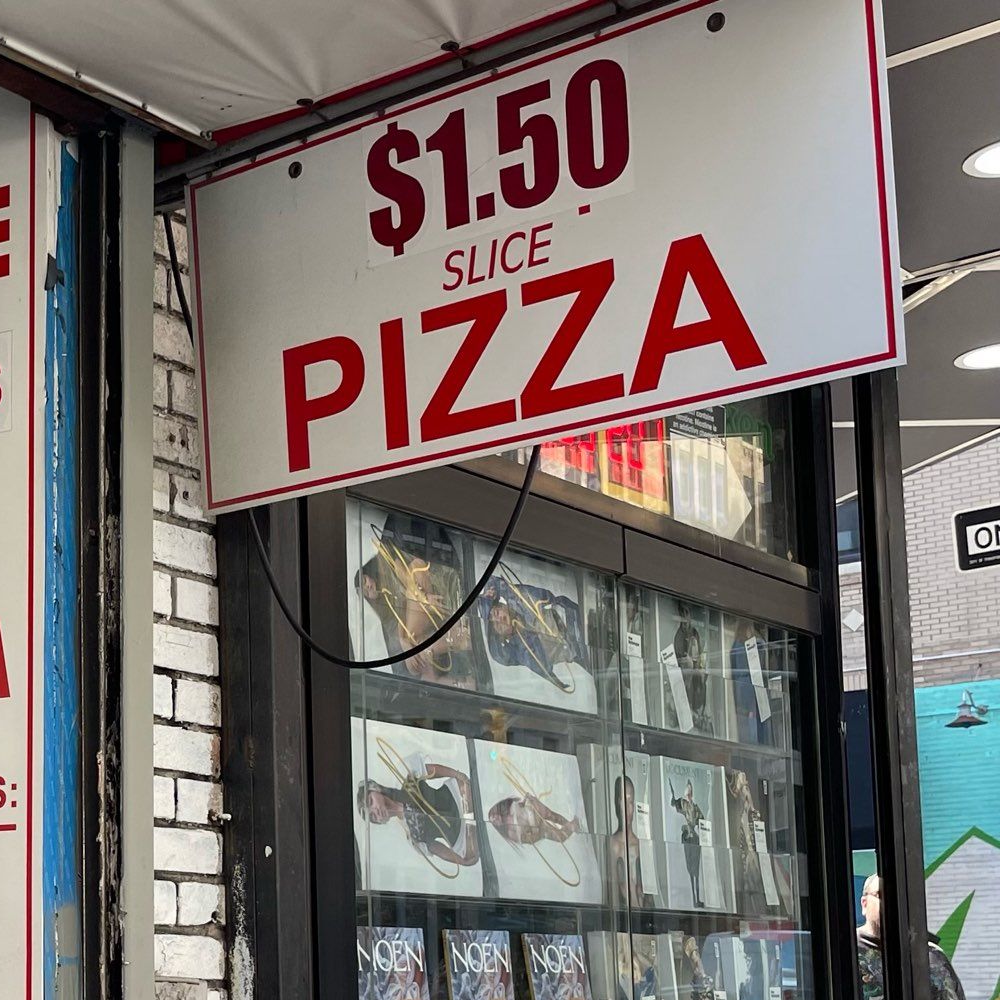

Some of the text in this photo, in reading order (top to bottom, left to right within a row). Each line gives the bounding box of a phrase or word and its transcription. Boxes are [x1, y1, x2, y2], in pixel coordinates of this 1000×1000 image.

[366, 57, 631, 258] $1.50
[442, 222, 553, 291] SLICE
[282, 232, 768, 474] PIZZA
[974, 524, 1000, 549] O
